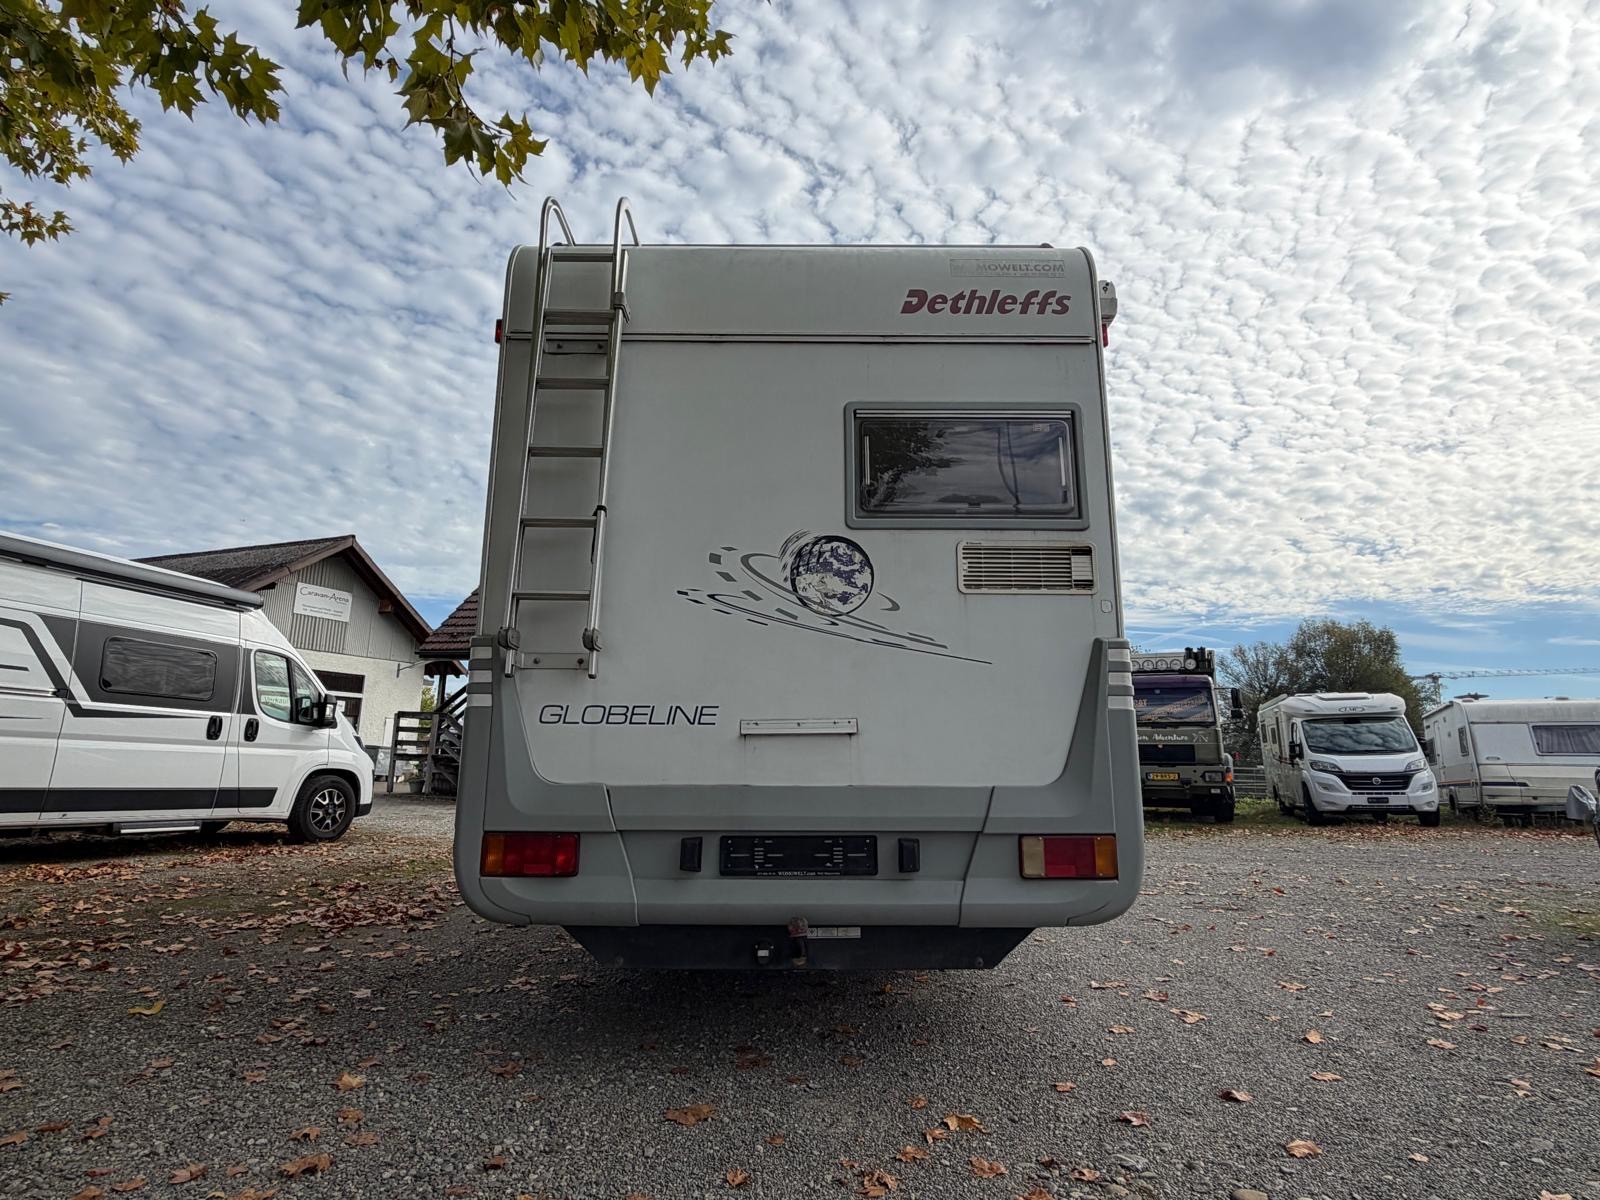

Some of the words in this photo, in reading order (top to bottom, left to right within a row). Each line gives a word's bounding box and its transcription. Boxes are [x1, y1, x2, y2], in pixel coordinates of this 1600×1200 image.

[900, 289, 1072, 315] Dethleffs
[299, 586, 350, 602] Caravan-Arena
[539, 704, 719, 725] GLOBELINE
